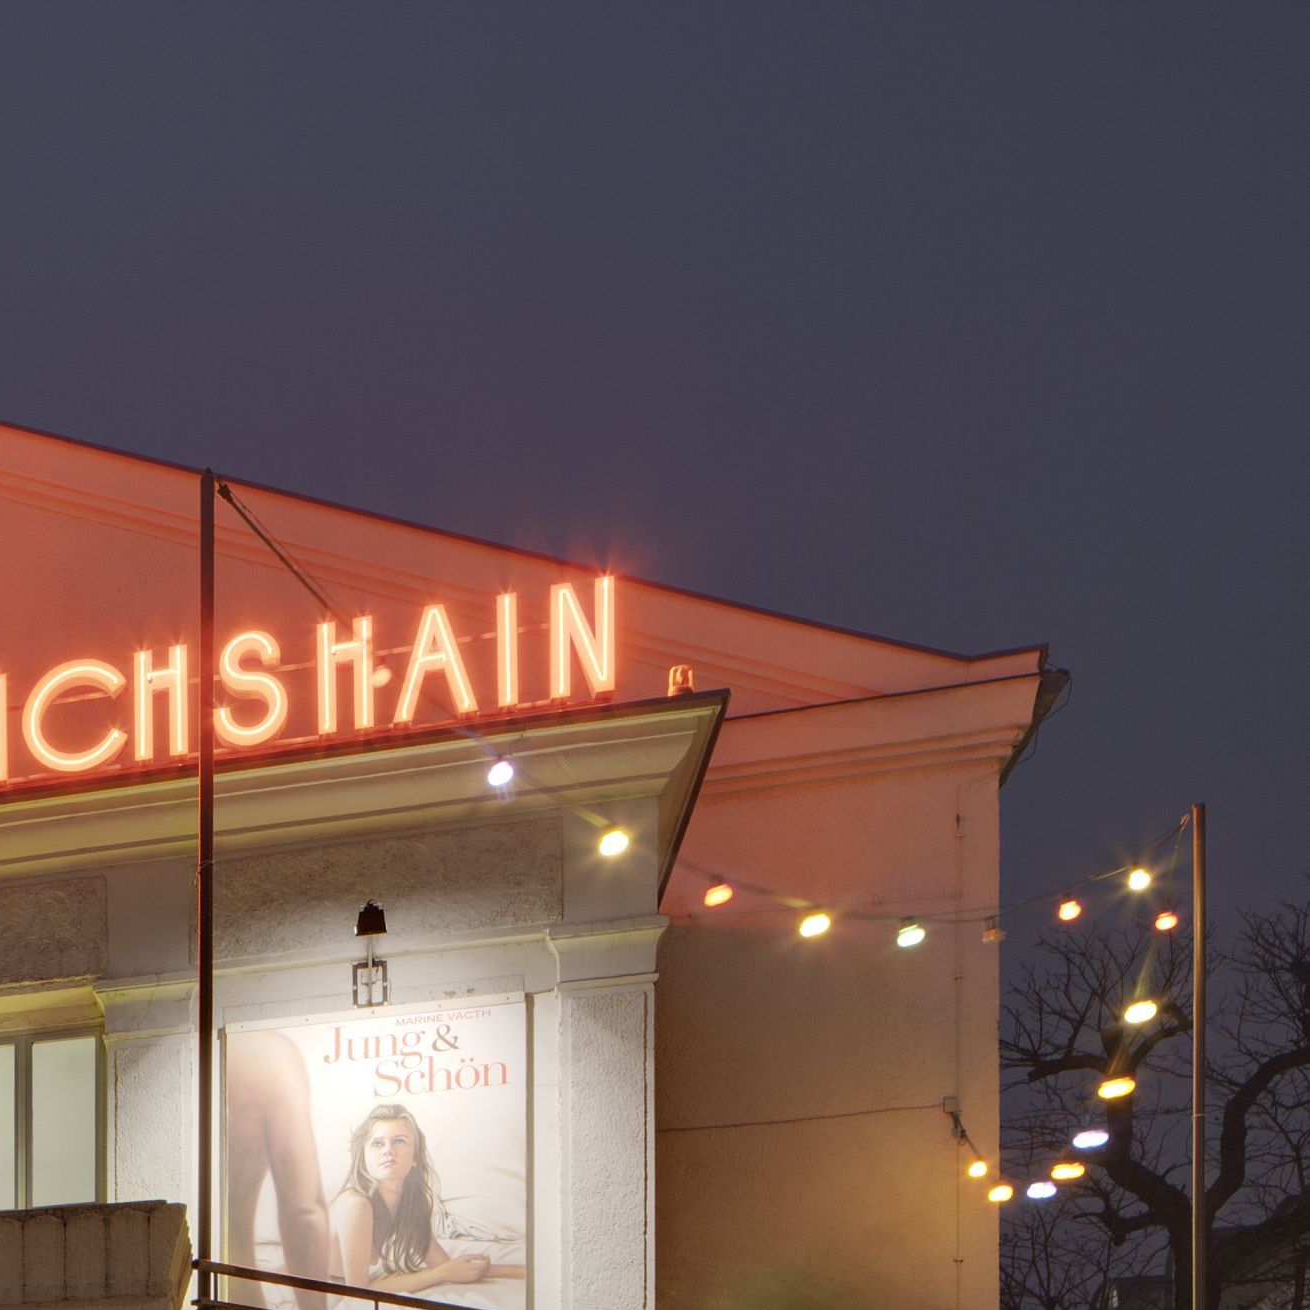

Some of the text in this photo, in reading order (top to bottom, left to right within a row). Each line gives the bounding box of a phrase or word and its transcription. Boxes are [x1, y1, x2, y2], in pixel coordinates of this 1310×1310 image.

[396, 1014, 443, 1026] MARINE
[323, 1024, 461, 1069] Jung &
[374, 1056, 510, 1097] Schön
